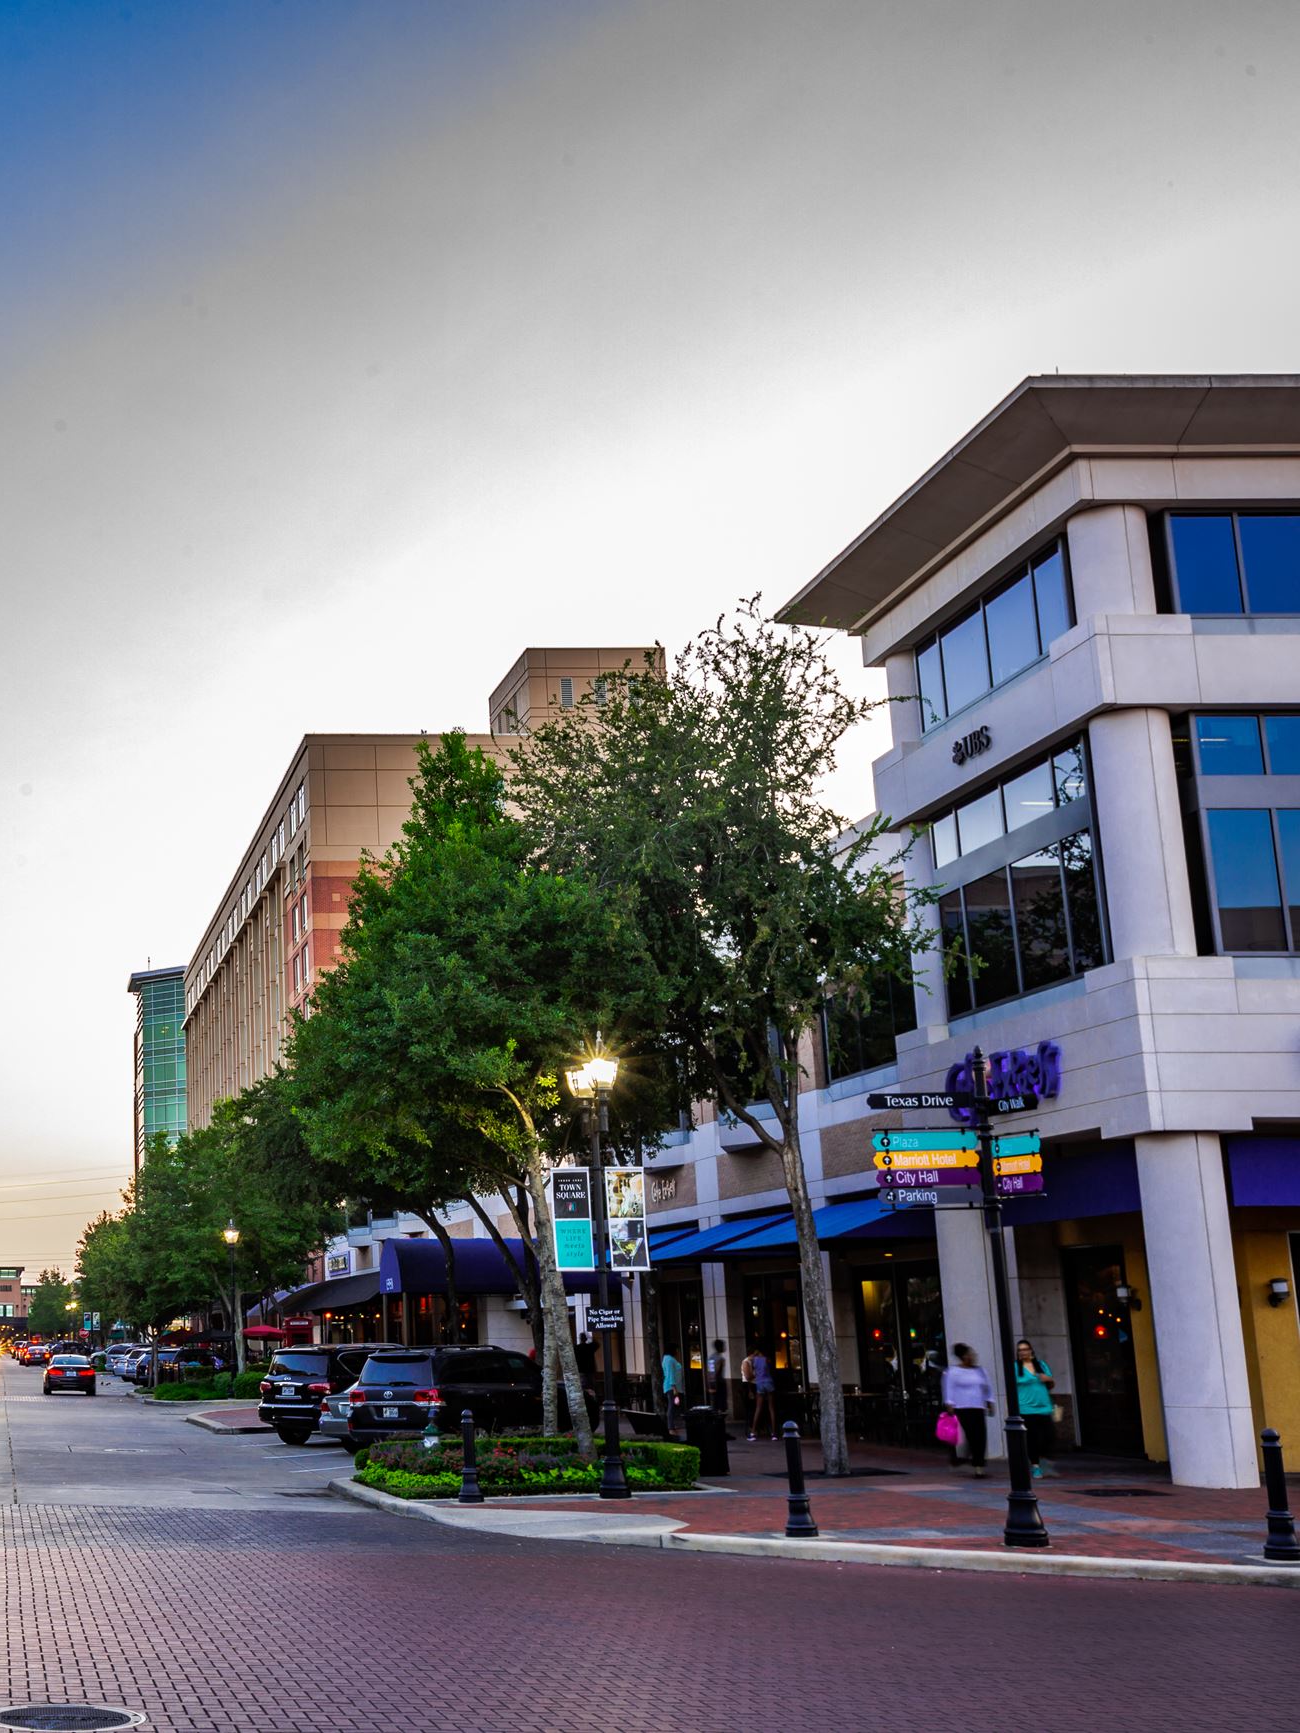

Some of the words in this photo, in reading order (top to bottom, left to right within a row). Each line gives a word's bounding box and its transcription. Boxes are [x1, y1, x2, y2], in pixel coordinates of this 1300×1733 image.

[962, 725, 991, 758] UBS
[884, 1095, 919, 1107] Texas
[921, 1094, 954, 1107] Drive
[998, 1100, 1010, 1112] City
[1010, 1097, 1025, 1110] Walk
[892, 1136, 919, 1148] Plaza
[893, 1153, 930, 1167] Marriott
[931, 1152, 957, 1165] Hotel
[896, 1171, 916, 1186] City
[918, 1170, 939, 1183] Hall
[1003, 1177, 1012, 1192] City
[1012, 1176, 1023, 1188] Hall
[559, 1183, 582, 1191] TOWN
[556, 1191, 586, 1200] SQUARE
[898, 1189, 938, 1204] Parking
